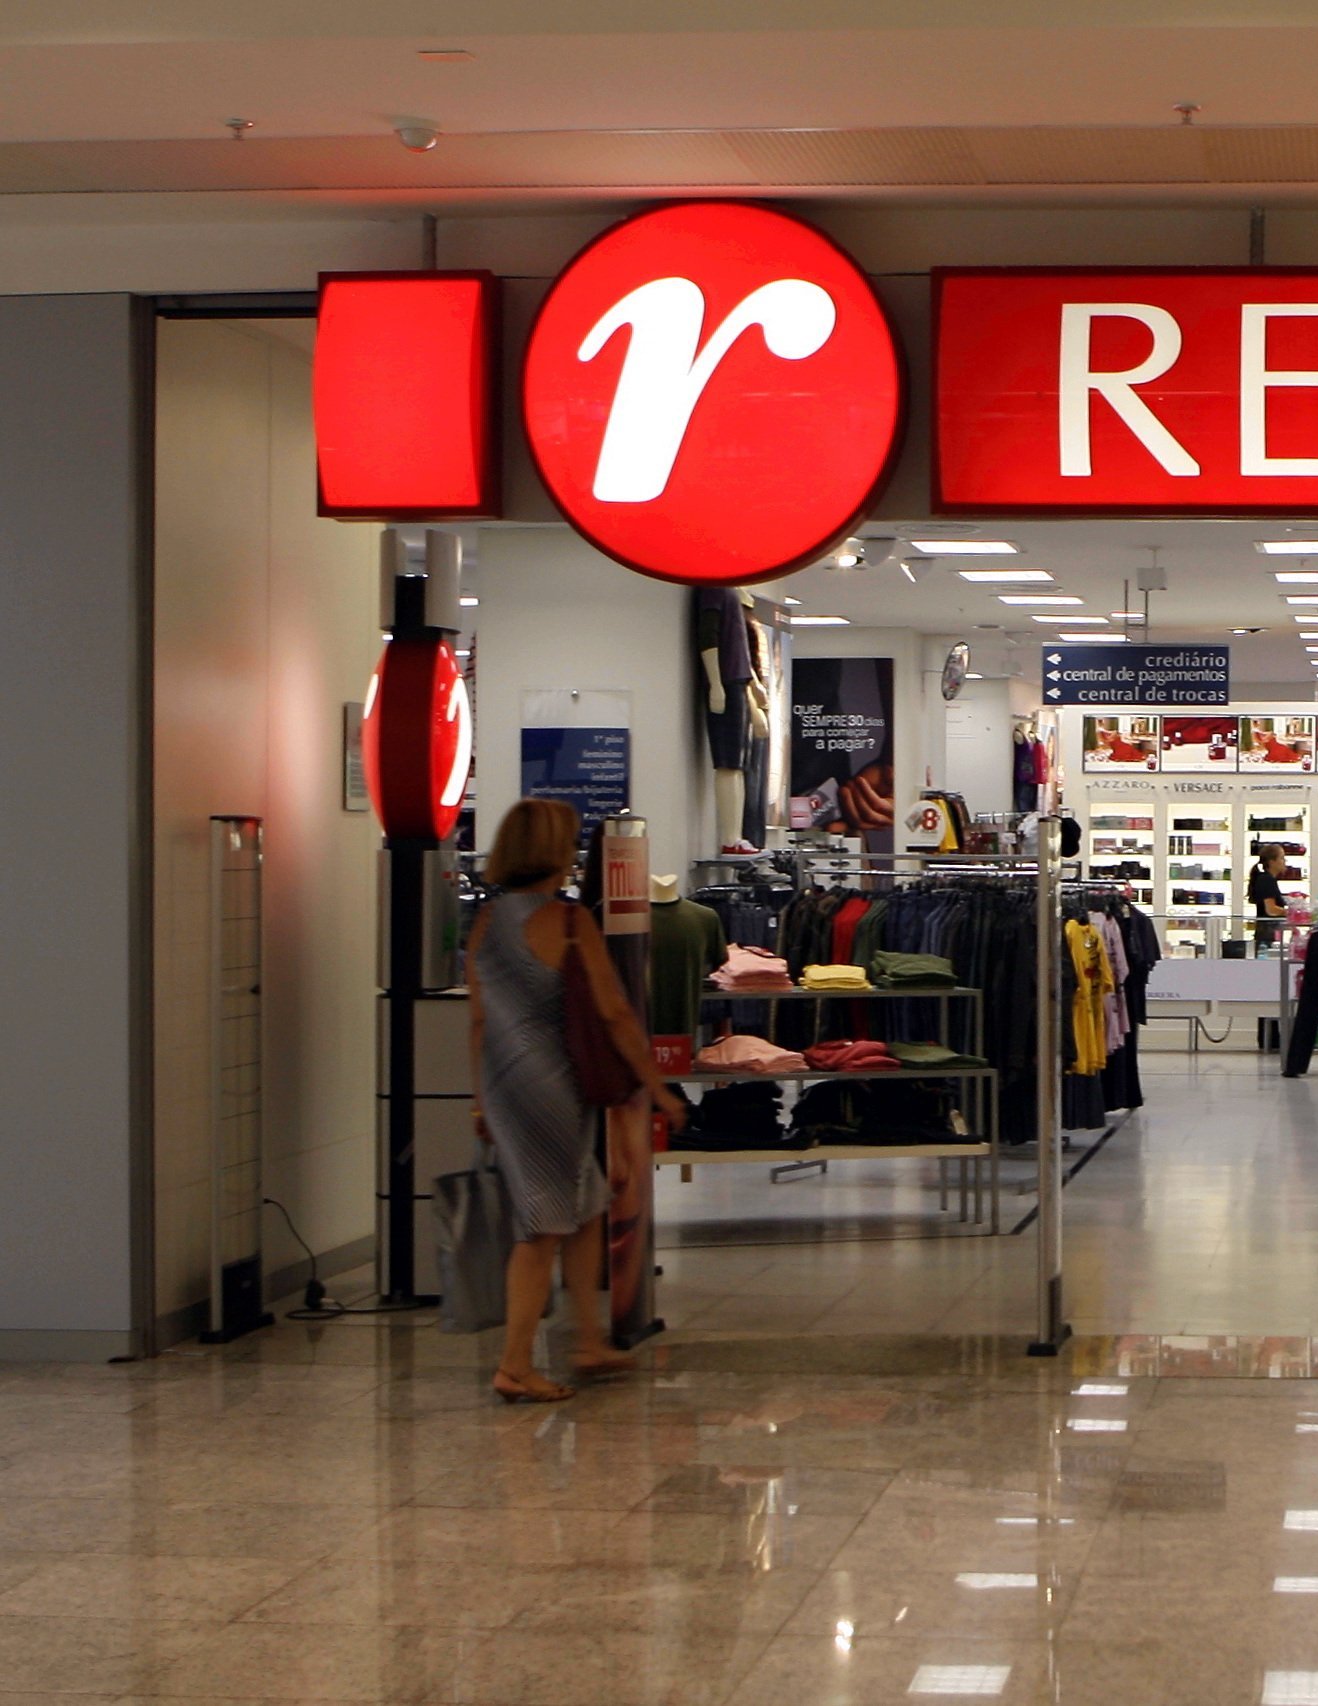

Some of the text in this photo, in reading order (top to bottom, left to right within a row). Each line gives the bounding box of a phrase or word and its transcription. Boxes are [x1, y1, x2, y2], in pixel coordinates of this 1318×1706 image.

[577, 277, 836, 503] r
[1145, 651, 1227, 668] crediário
[1062, 665, 1227, 686] central de pagamentos
[1077, 686, 1227, 702] central de trocas
[792, 704, 824, 717] quer
[802, 715, 847, 727] SEMPRE
[847, 714, 864, 726] 30
[802, 728, 825, 739] para
[815, 738, 876, 752] a pagar?
[1092, 780, 1150, 789] AZZARO
[1173, 782, 1223, 793] VERSACE
